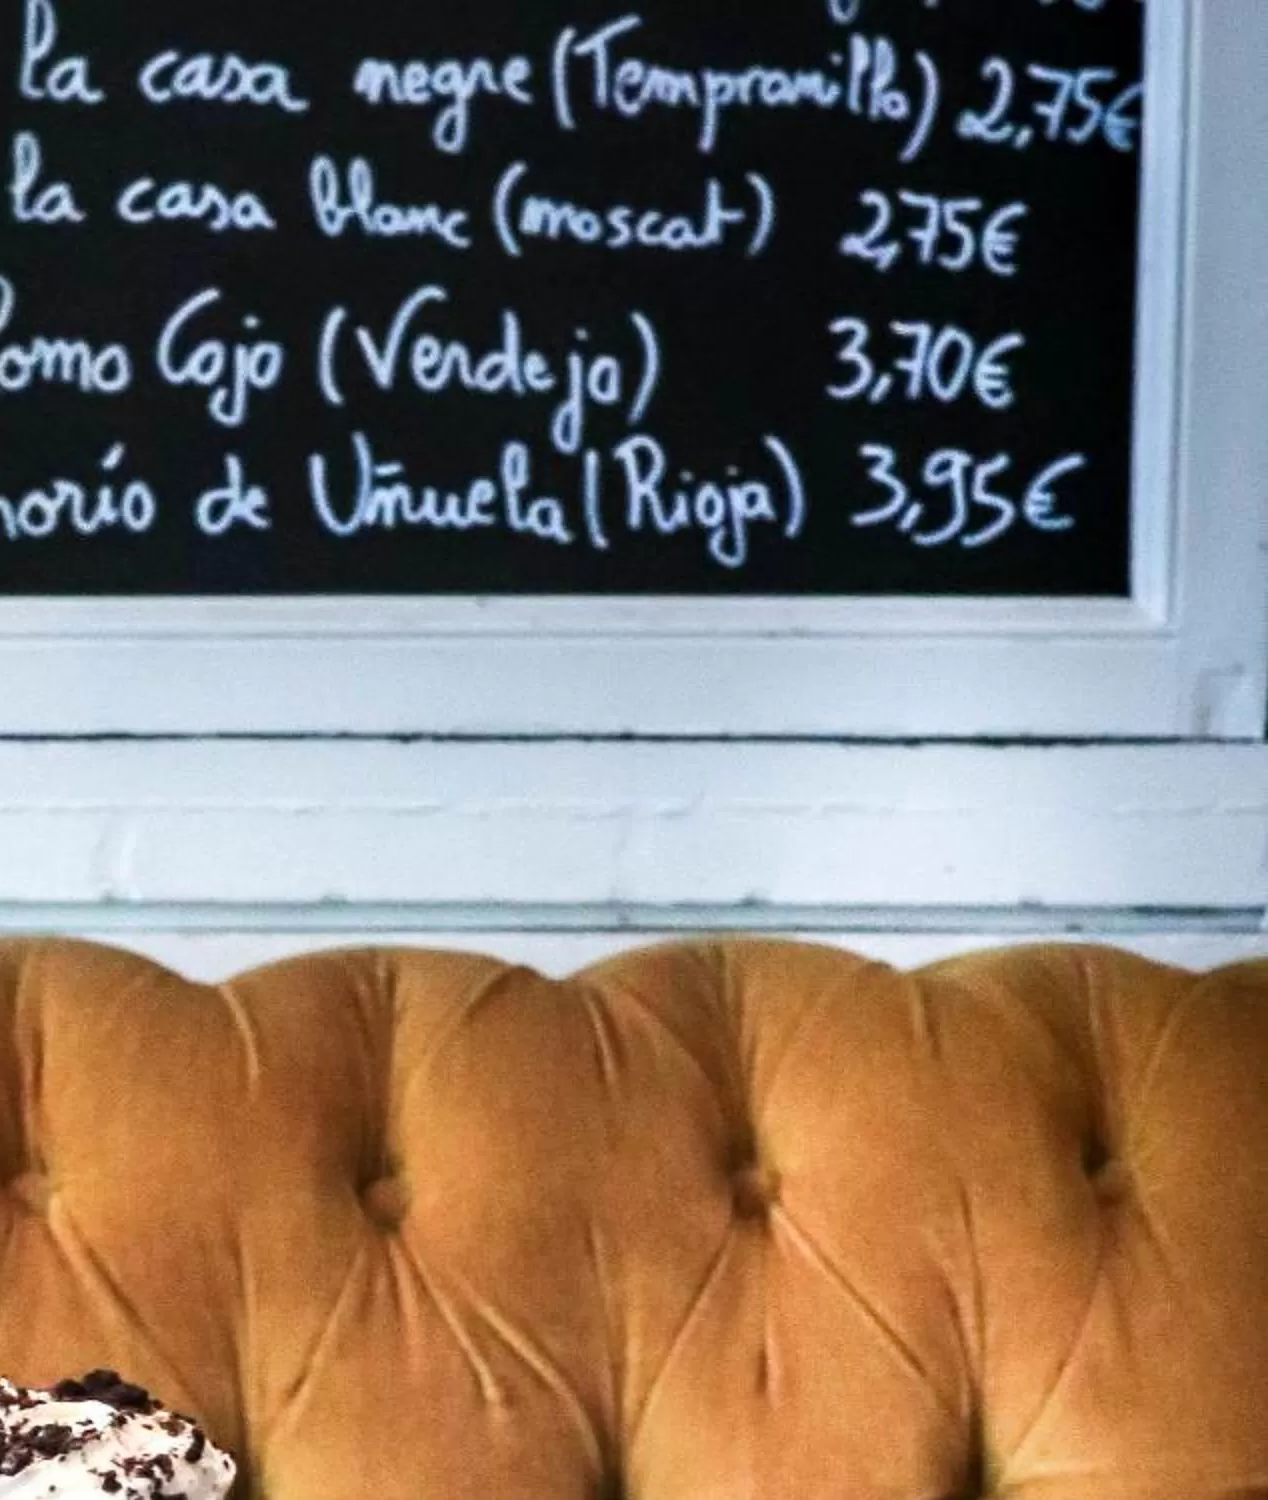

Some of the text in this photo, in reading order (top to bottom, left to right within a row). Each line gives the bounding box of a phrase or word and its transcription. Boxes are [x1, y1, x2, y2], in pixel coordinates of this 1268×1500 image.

[20, 0, 105, 102] la
[140, 51, 309, 112] casa
[354, 57, 532, 153] negre
[11, 131, 87, 222] la
[117, 177, 276, 231] casa
[310, 155, 472, 247] blanc
[493, 162, 774, 257] (moscat)
[840, 190, 1029, 274] 2,75€
[157, 288, 284, 425] Cojo
[319, 285, 662, 455] (Verdejo)
[828, 318, 1025, 409] 3,70€
[196, 454, 272, 533] de
[583, 435, 804, 567] (Rioja)
[852, 443, 1087, 547] 3,95€
